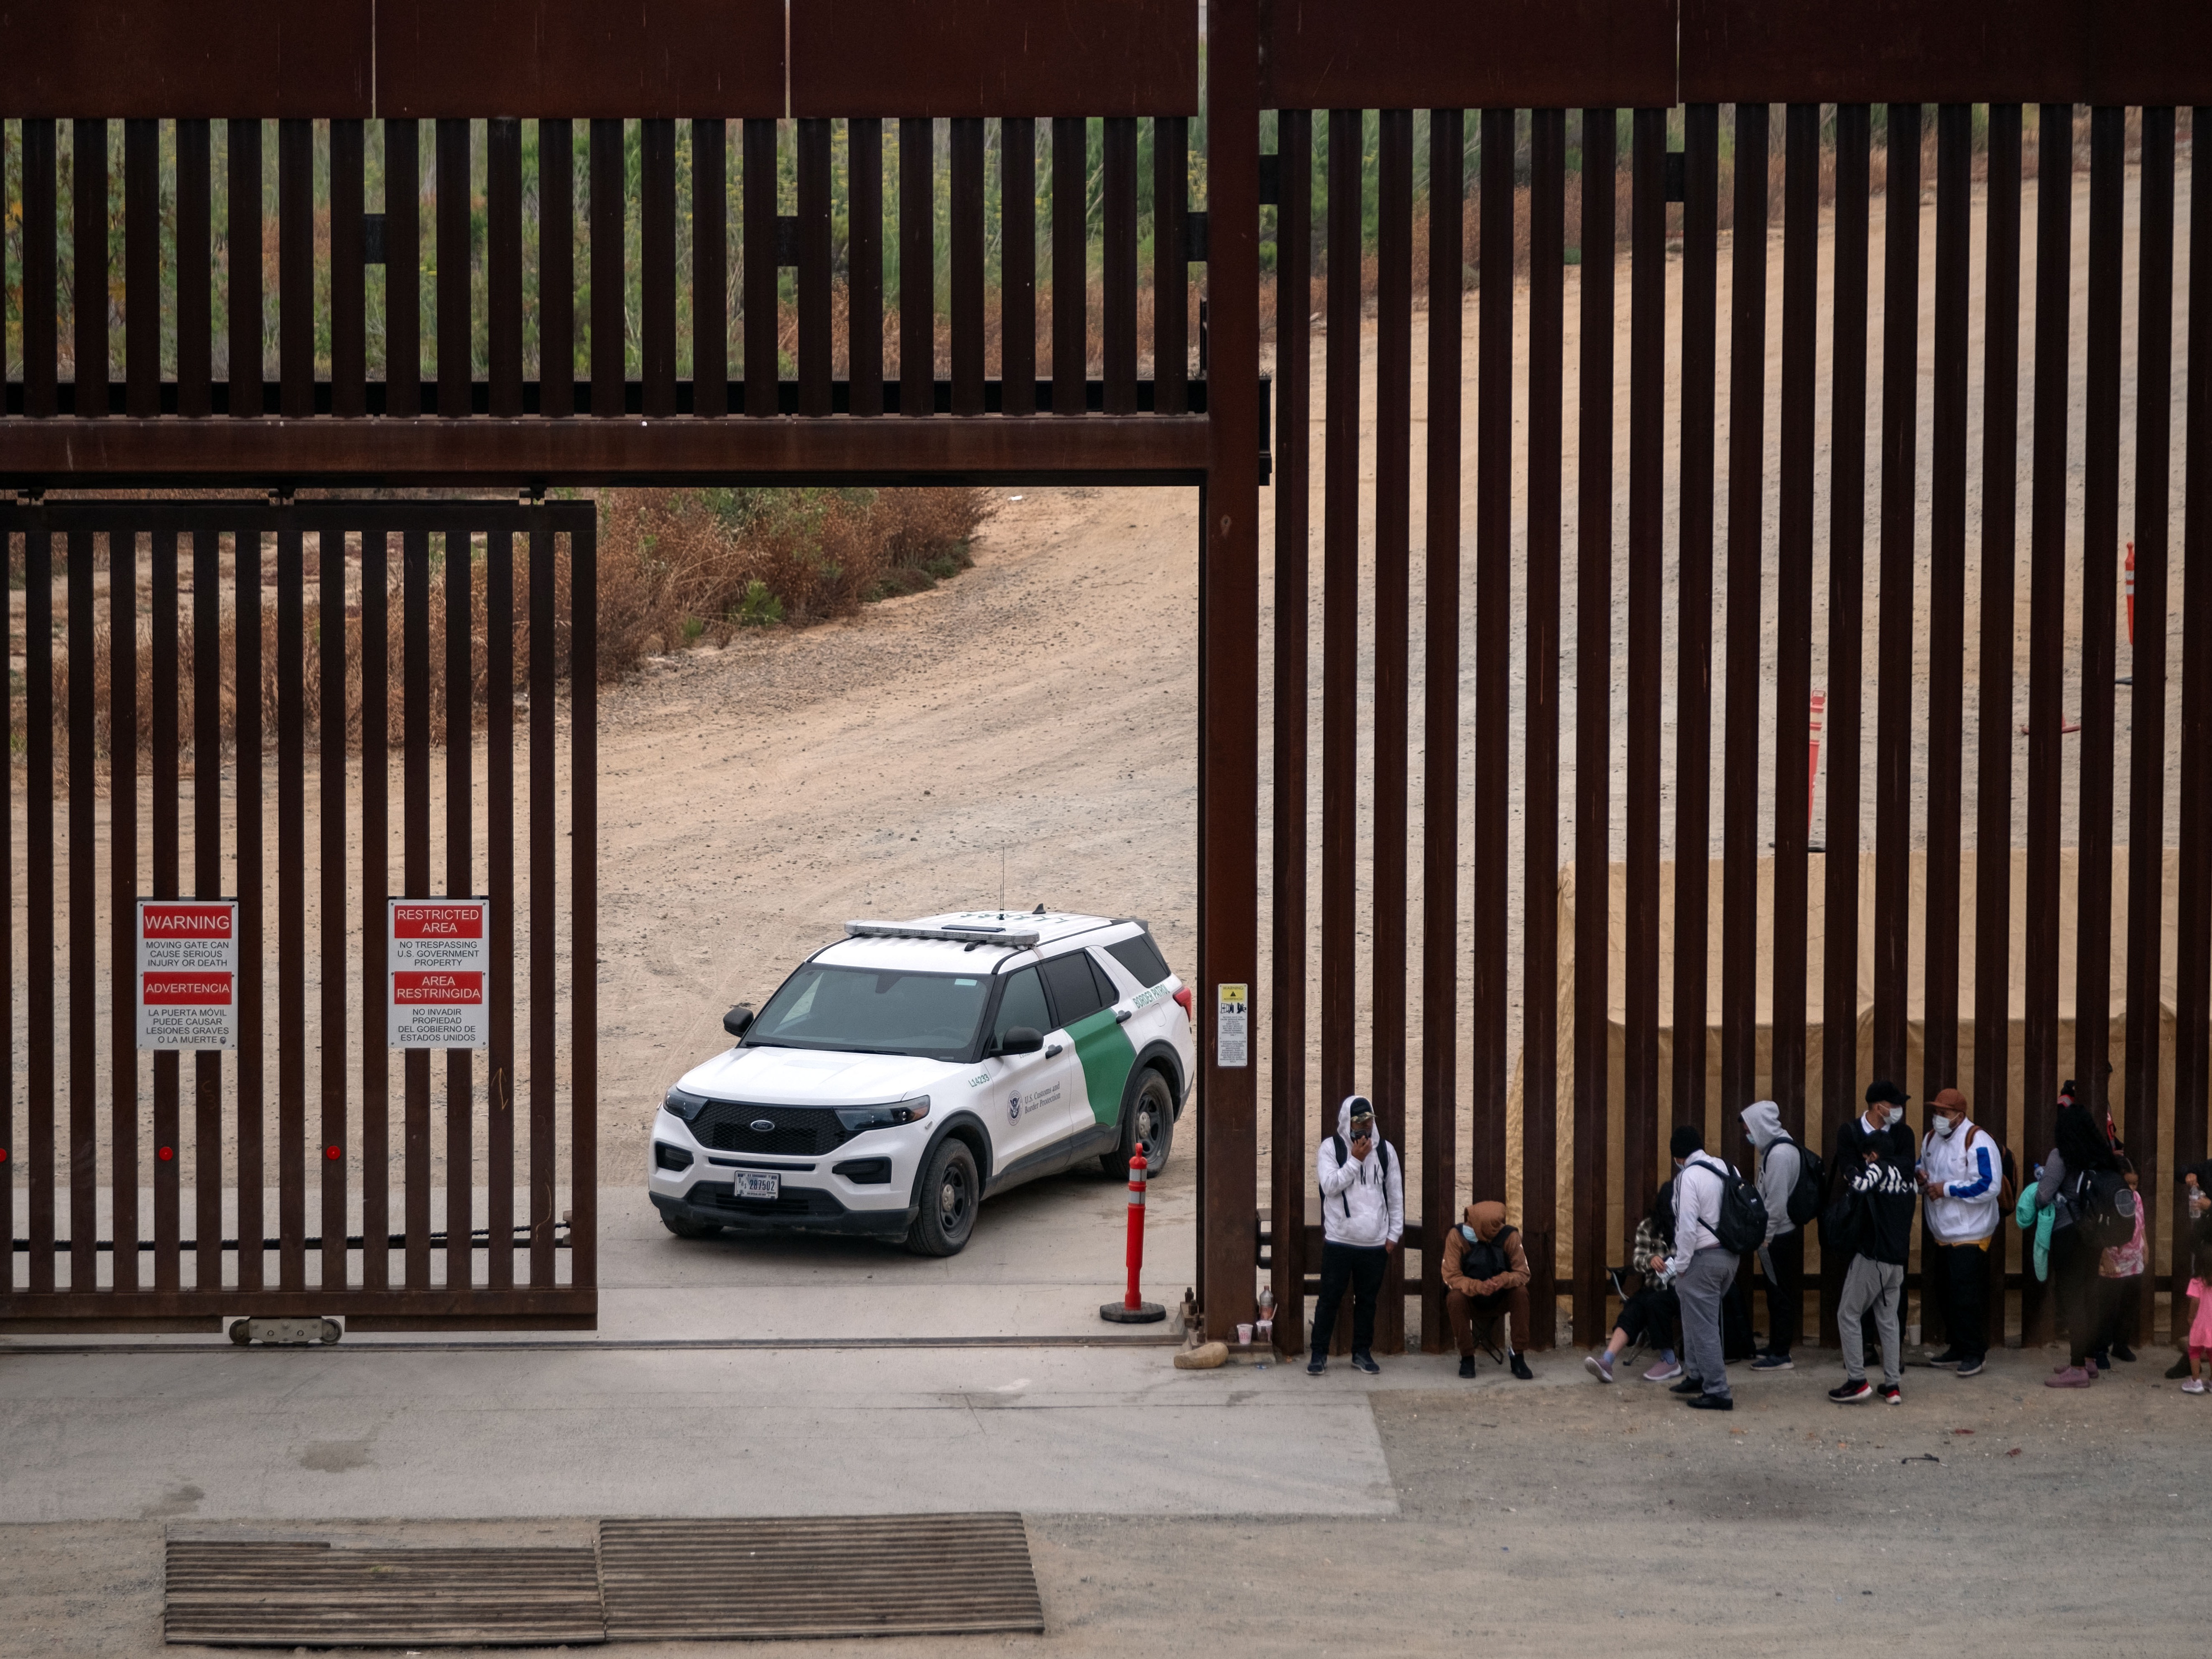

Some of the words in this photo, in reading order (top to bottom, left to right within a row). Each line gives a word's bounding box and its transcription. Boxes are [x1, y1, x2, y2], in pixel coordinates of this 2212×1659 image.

[398, 909, 479, 920] RESTRICTED
[145, 915, 230, 929] WARNING
[422, 922, 458, 933] AREA
[422, 976, 456, 986] AREA
[146, 983, 230, 993] ADVERTENCIA
[397, 988, 481, 998] RESTRINGIDA
[1133, 991, 1155, 1009] BORDER
[1151, 983, 1170, 999] PATROL
[968, 1074, 990, 1087] L14233
[1034, 1087, 1051, 1100] Customs
[1025, 1102, 1038, 1114] Border
[1040, 1093, 1061, 1107] Protection
[750, 1179, 775, 1191] 287502
